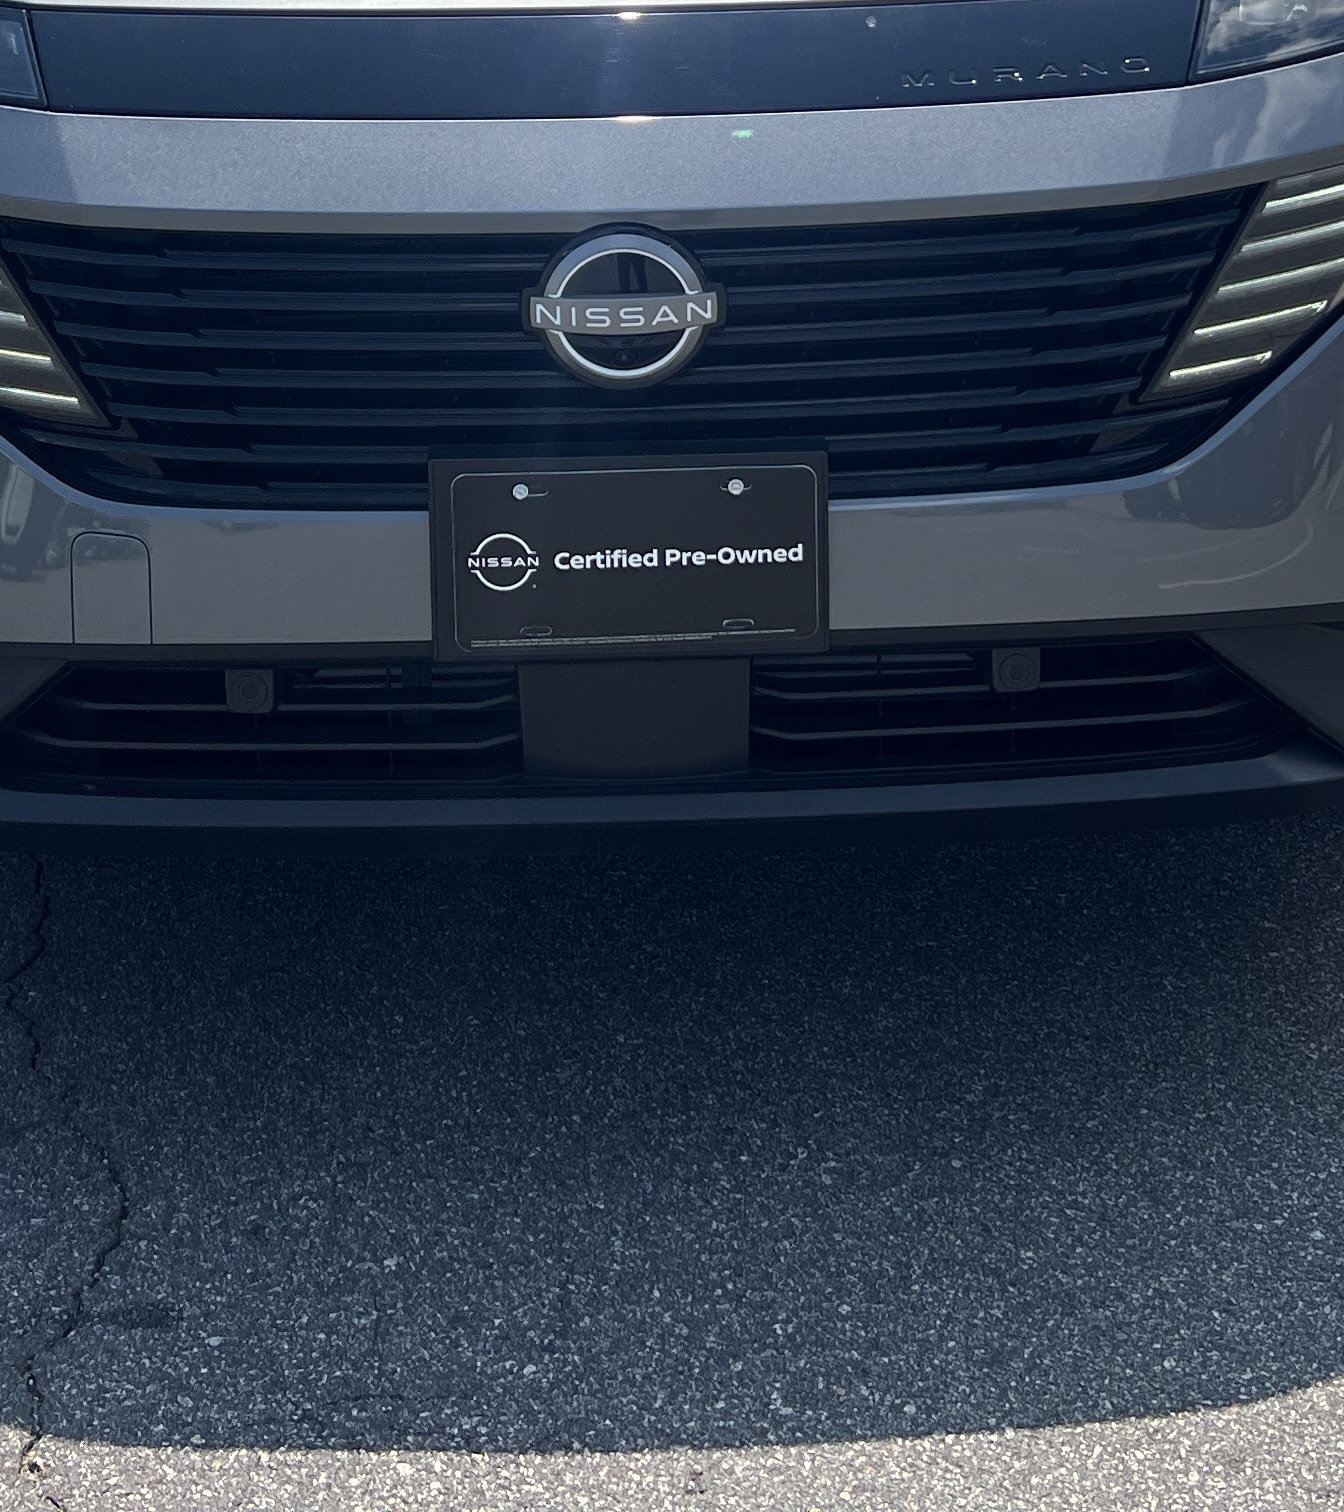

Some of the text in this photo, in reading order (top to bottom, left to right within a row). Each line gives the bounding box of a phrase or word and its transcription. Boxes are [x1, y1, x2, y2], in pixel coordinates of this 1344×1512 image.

[902, 55, 1150, 88] MURANO
[535, 298, 713, 328] NISSAN
[467, 556, 540, 568] NISSAN
[554, 543, 804, 570] Certified Pre-Owned
